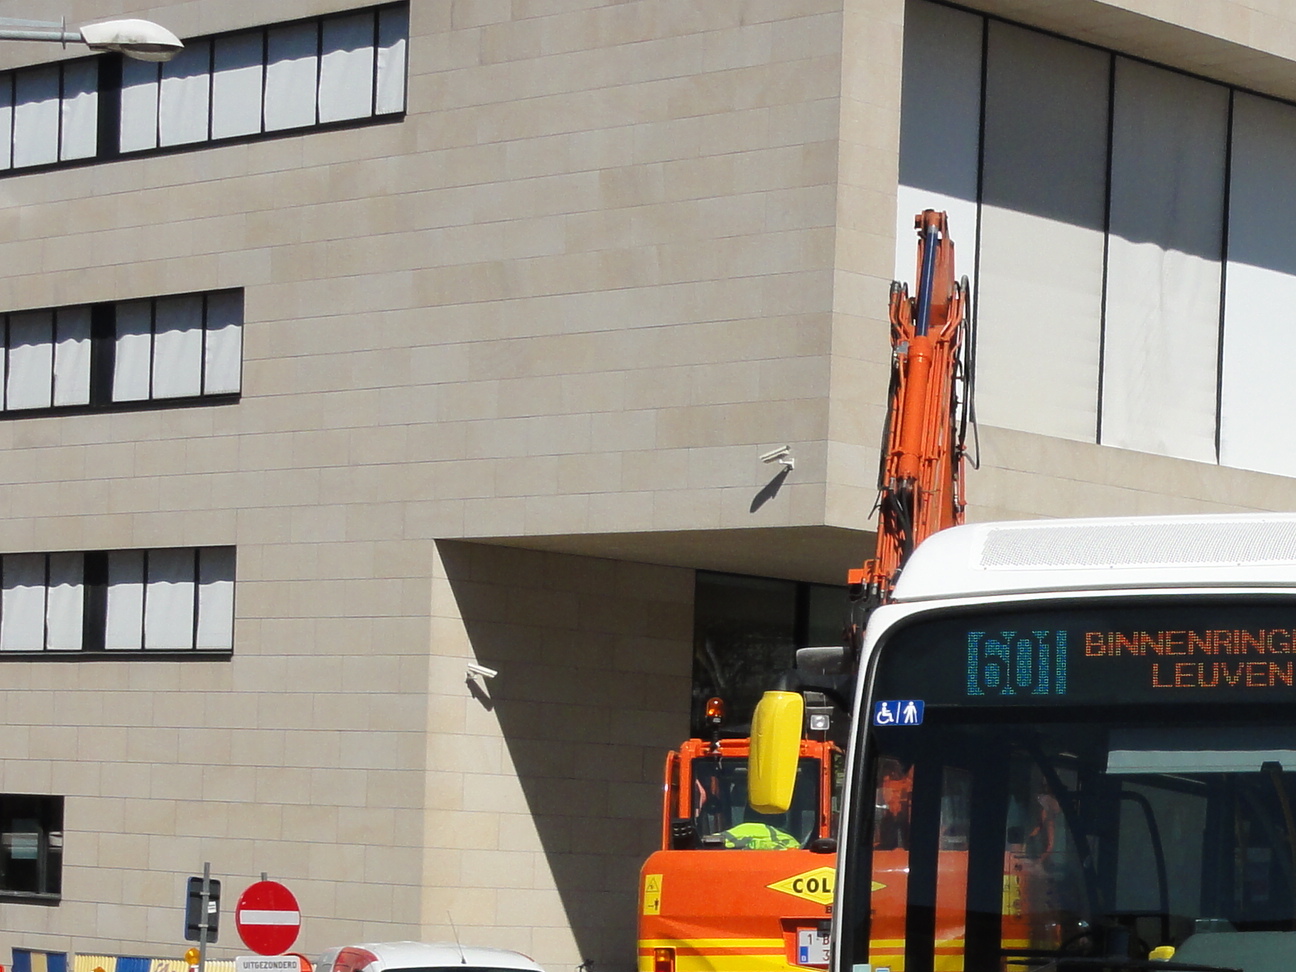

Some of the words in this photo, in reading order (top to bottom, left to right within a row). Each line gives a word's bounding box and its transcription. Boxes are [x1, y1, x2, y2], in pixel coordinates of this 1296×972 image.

[1152, 661, 1293, 688] LEUVEN
[792, 878, 835, 894] COL
[243, 961, 297, 969] UITGEZONDERD
